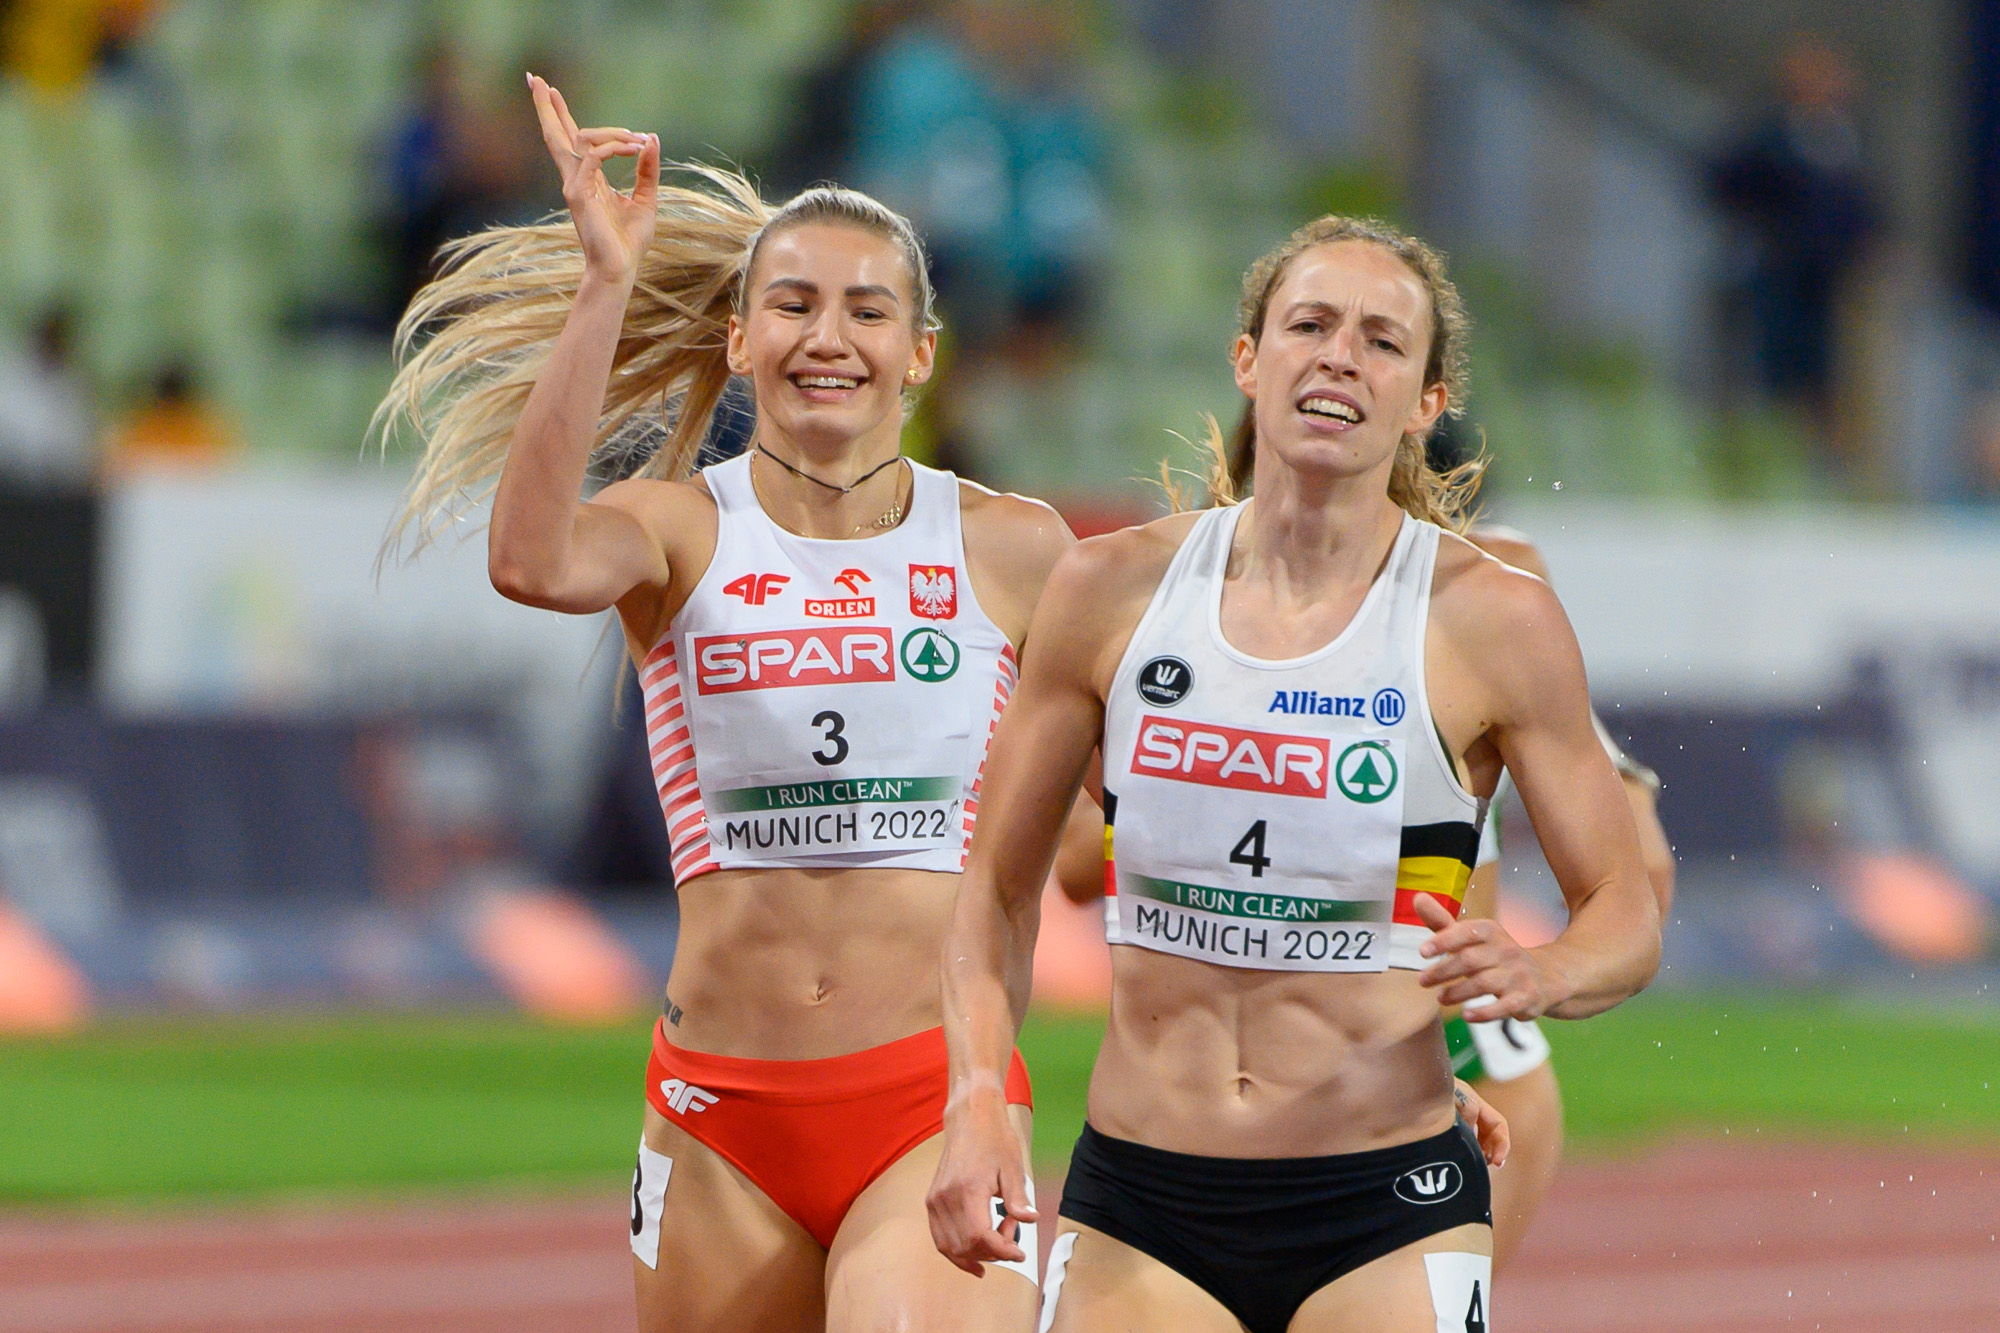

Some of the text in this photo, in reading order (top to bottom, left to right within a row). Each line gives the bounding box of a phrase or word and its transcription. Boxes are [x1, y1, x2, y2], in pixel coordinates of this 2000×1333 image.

[808, 600, 872, 617] ORLEN
[701, 634, 890, 685] SPAR
[1268, 690, 1366, 718] Allianz
[811, 710, 849, 766] 3
[1138, 723, 1325, 790] SPAR
[766, 790, 773, 806] I
[778, 784, 824, 805] RUN
[725, 808, 946, 850] MUNICH 2022
[1229, 819, 1271, 878] 4
[1175, 886, 1182, 903] I
[1187, 886, 1236, 911] RUN
[1136, 904, 1376, 960] MUNICH 2022
